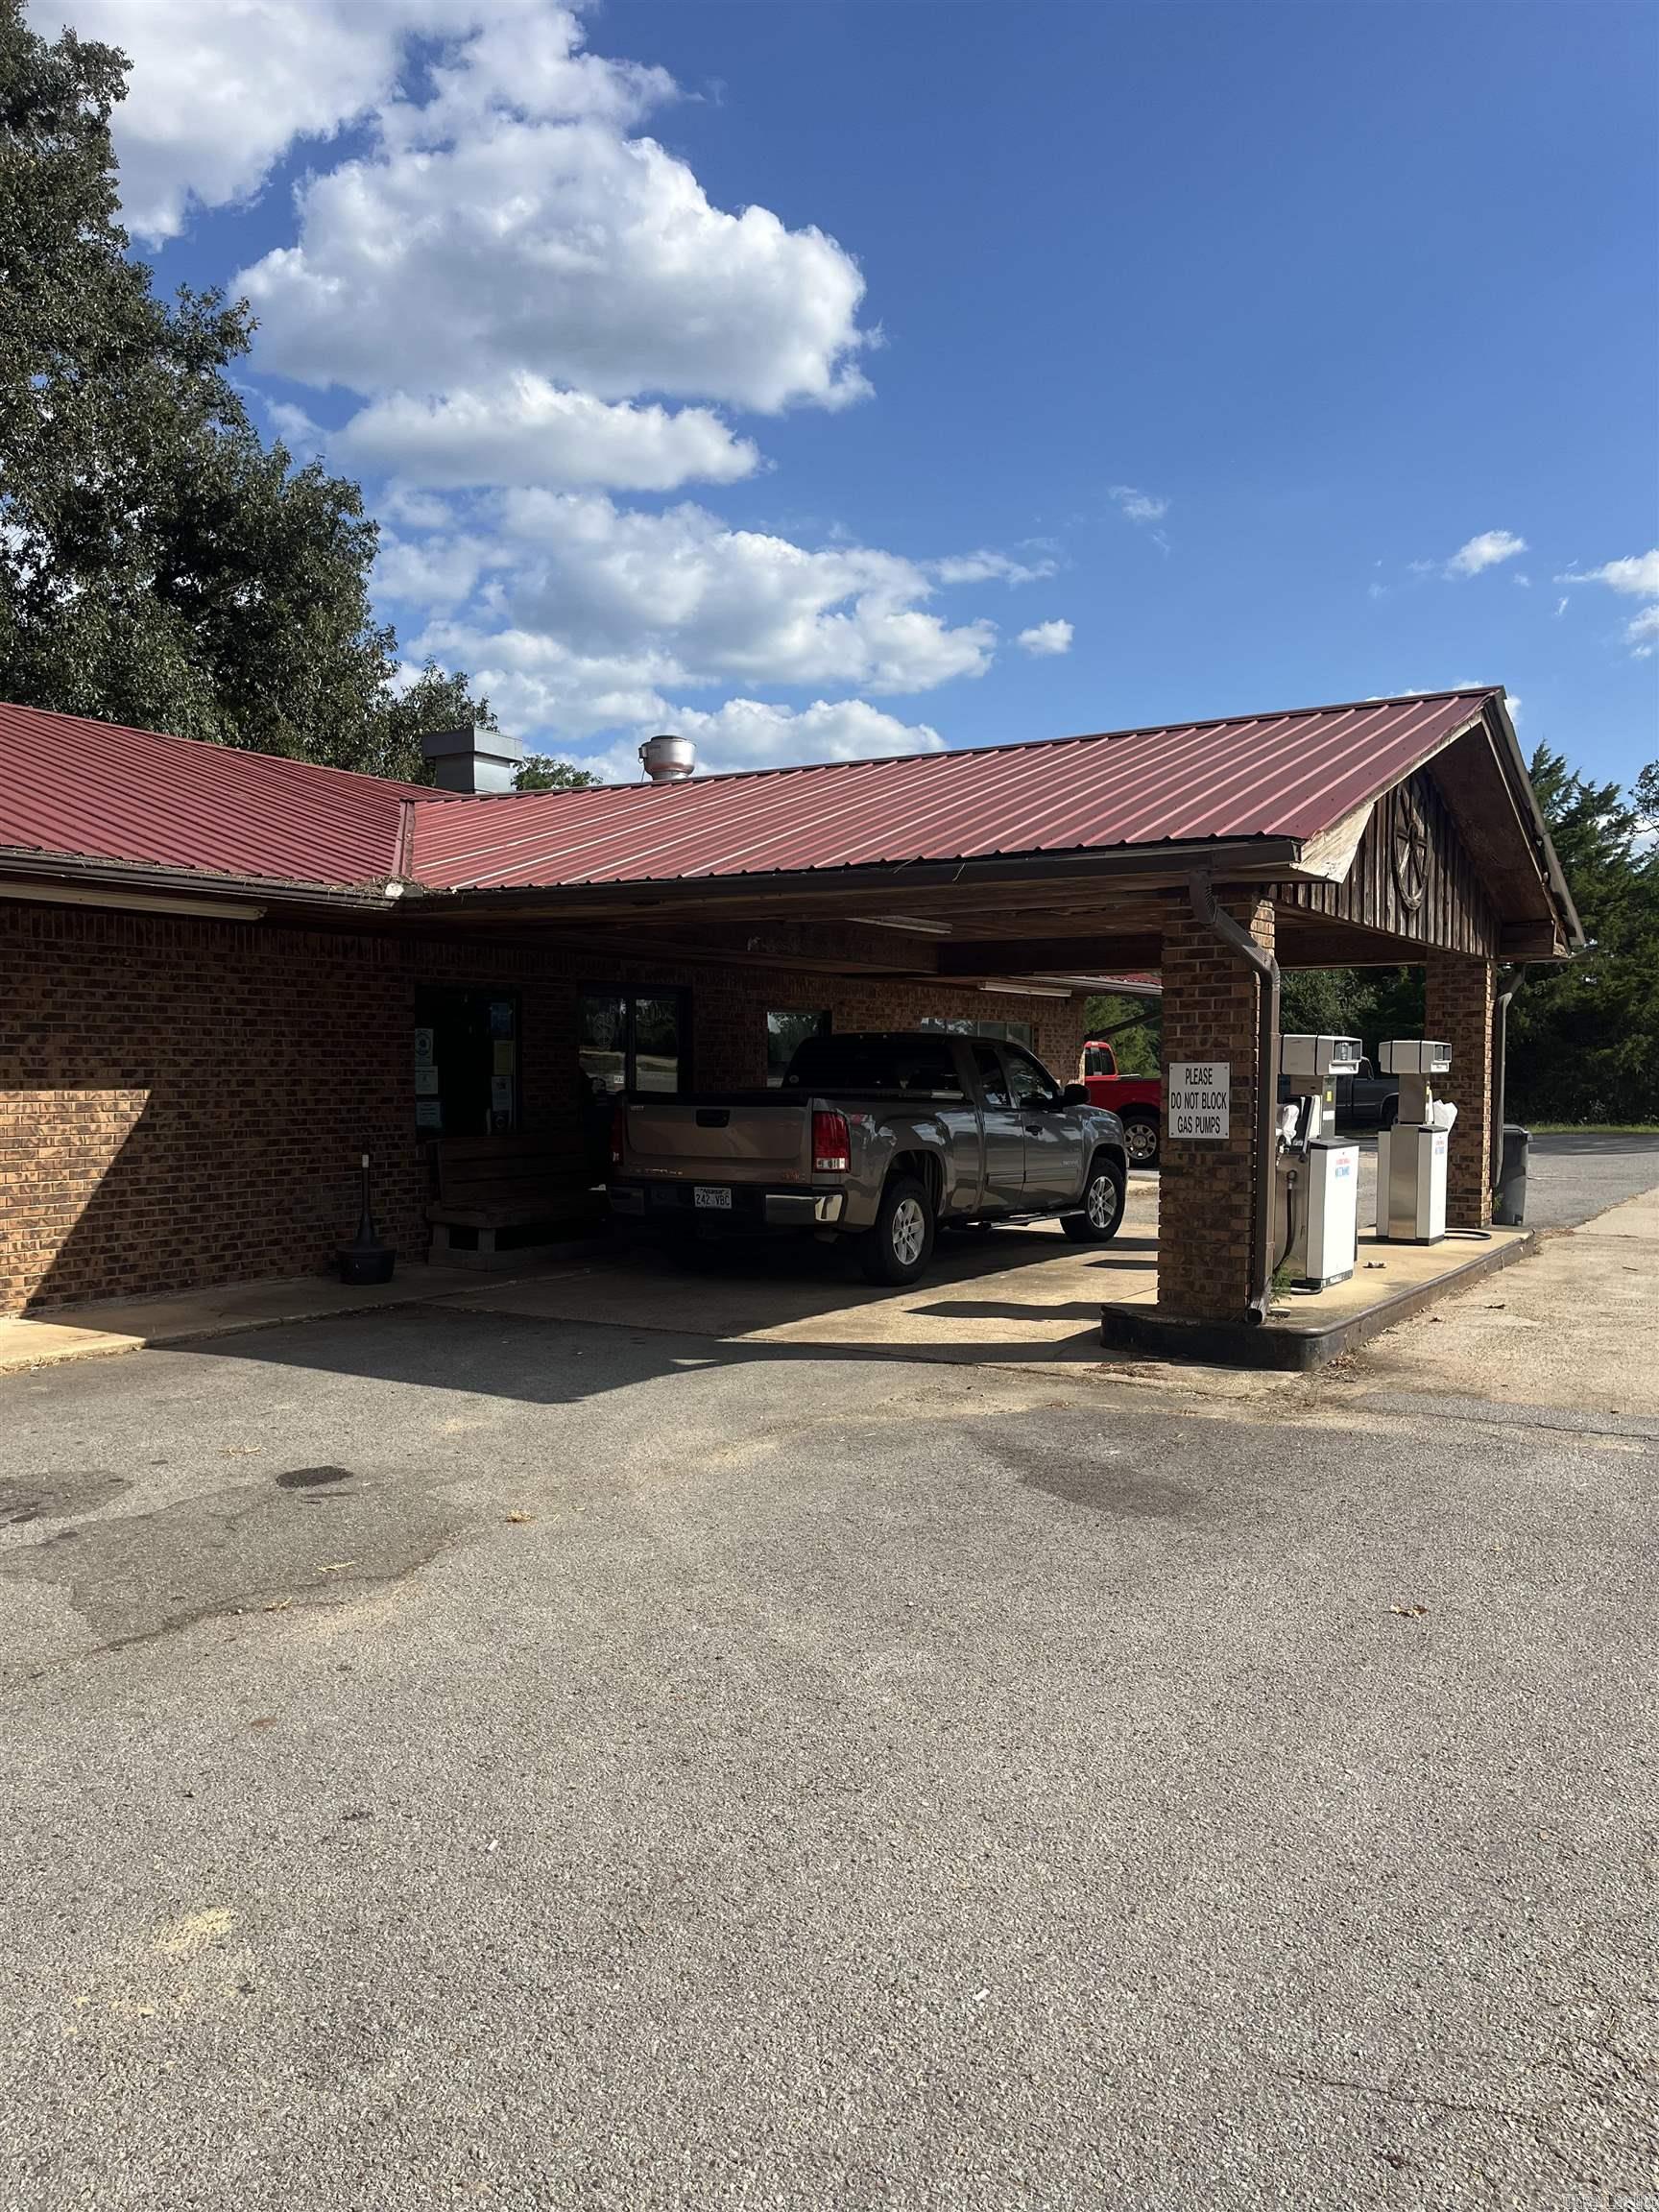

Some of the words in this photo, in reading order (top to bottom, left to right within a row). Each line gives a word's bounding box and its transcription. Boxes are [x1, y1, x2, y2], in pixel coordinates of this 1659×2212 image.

[1185, 1067, 1213, 1085] PLEASE
[1170, 1092, 1182, 1110] DO
[1184, 1092, 1199, 1110] NOT
[1201, 1092, 1227, 1110] BLOCK
[1177, 1116, 1192, 1134] GAS
[1195, 1116, 1220, 1134] PUMPS
[695, 1193, 710, 1205] 242
[715, 1194, 731, 1206] VBC
